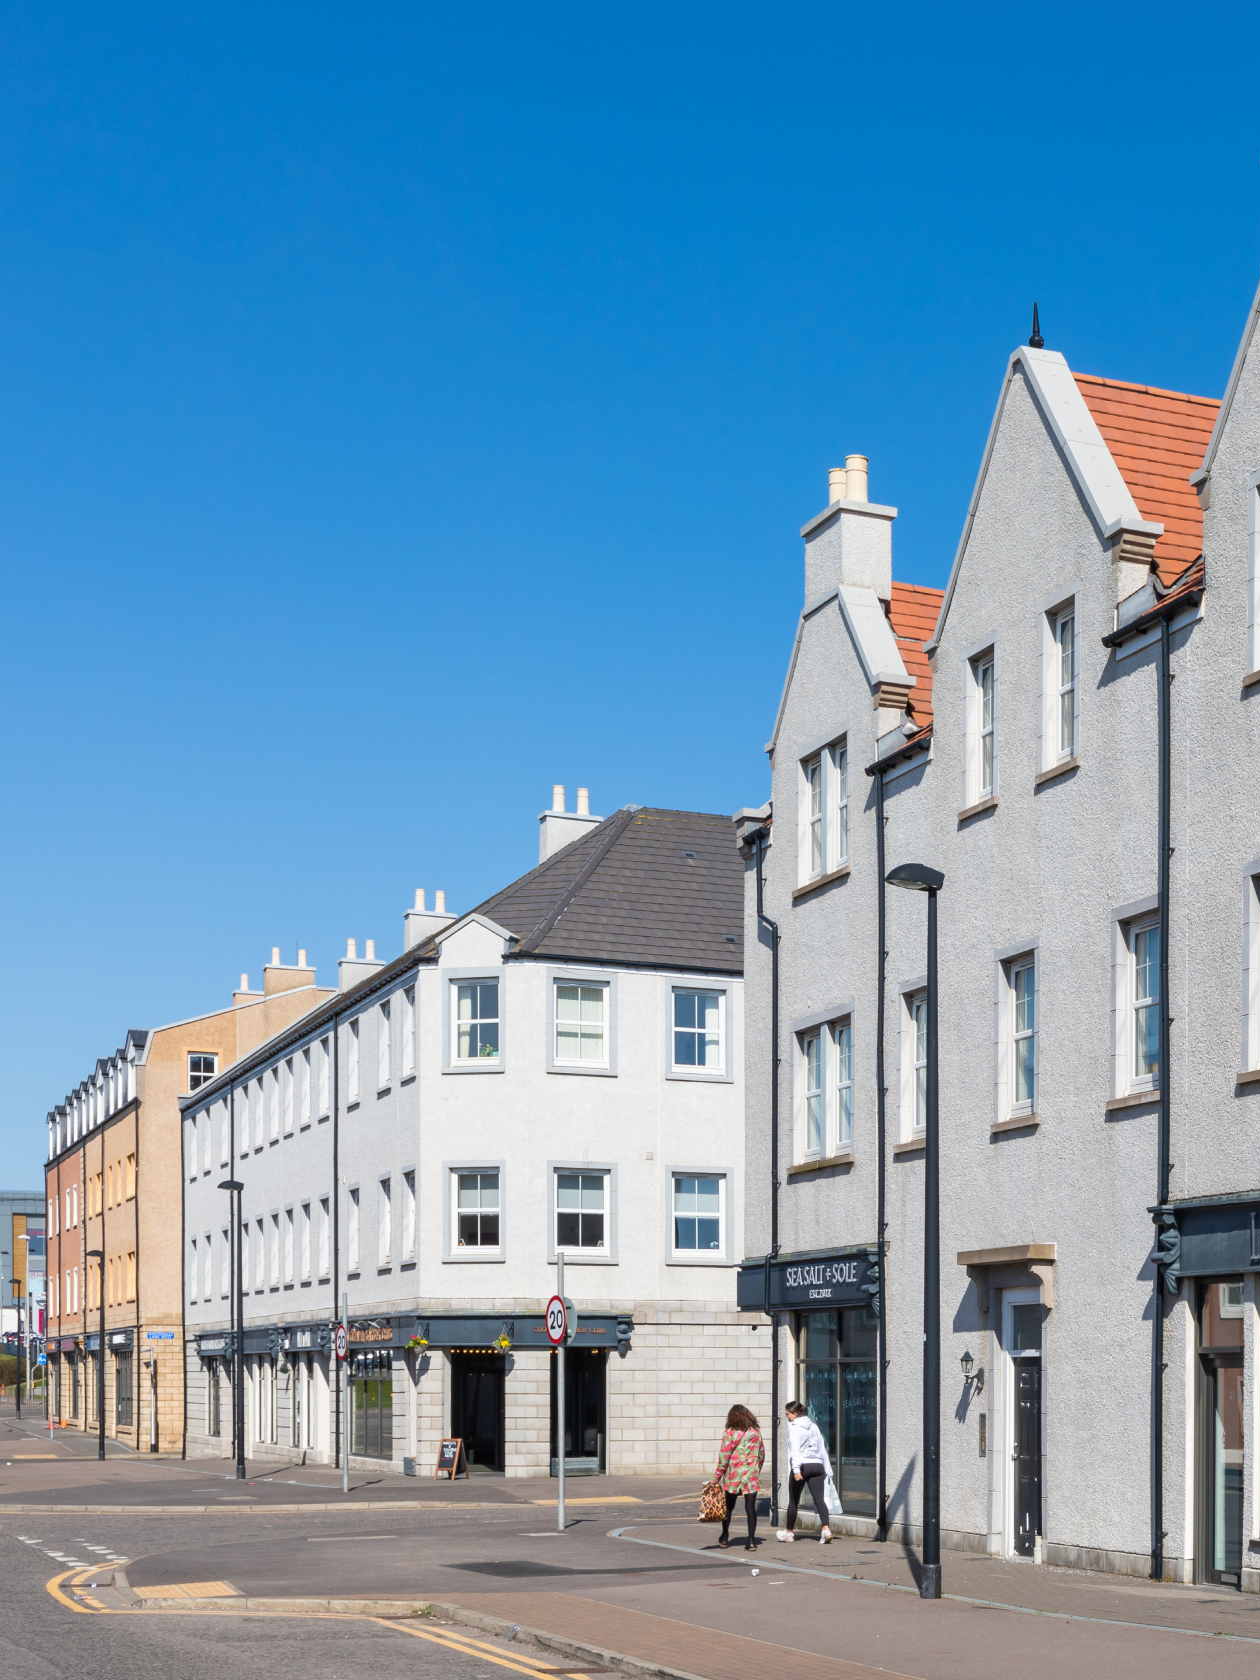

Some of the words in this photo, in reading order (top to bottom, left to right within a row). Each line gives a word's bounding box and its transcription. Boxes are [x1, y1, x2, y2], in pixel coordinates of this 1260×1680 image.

[832, 1262, 858, 1283] SOLE
[549, 1310, 563, 1330] 20
[337, 1335, 346, 1350] 20
